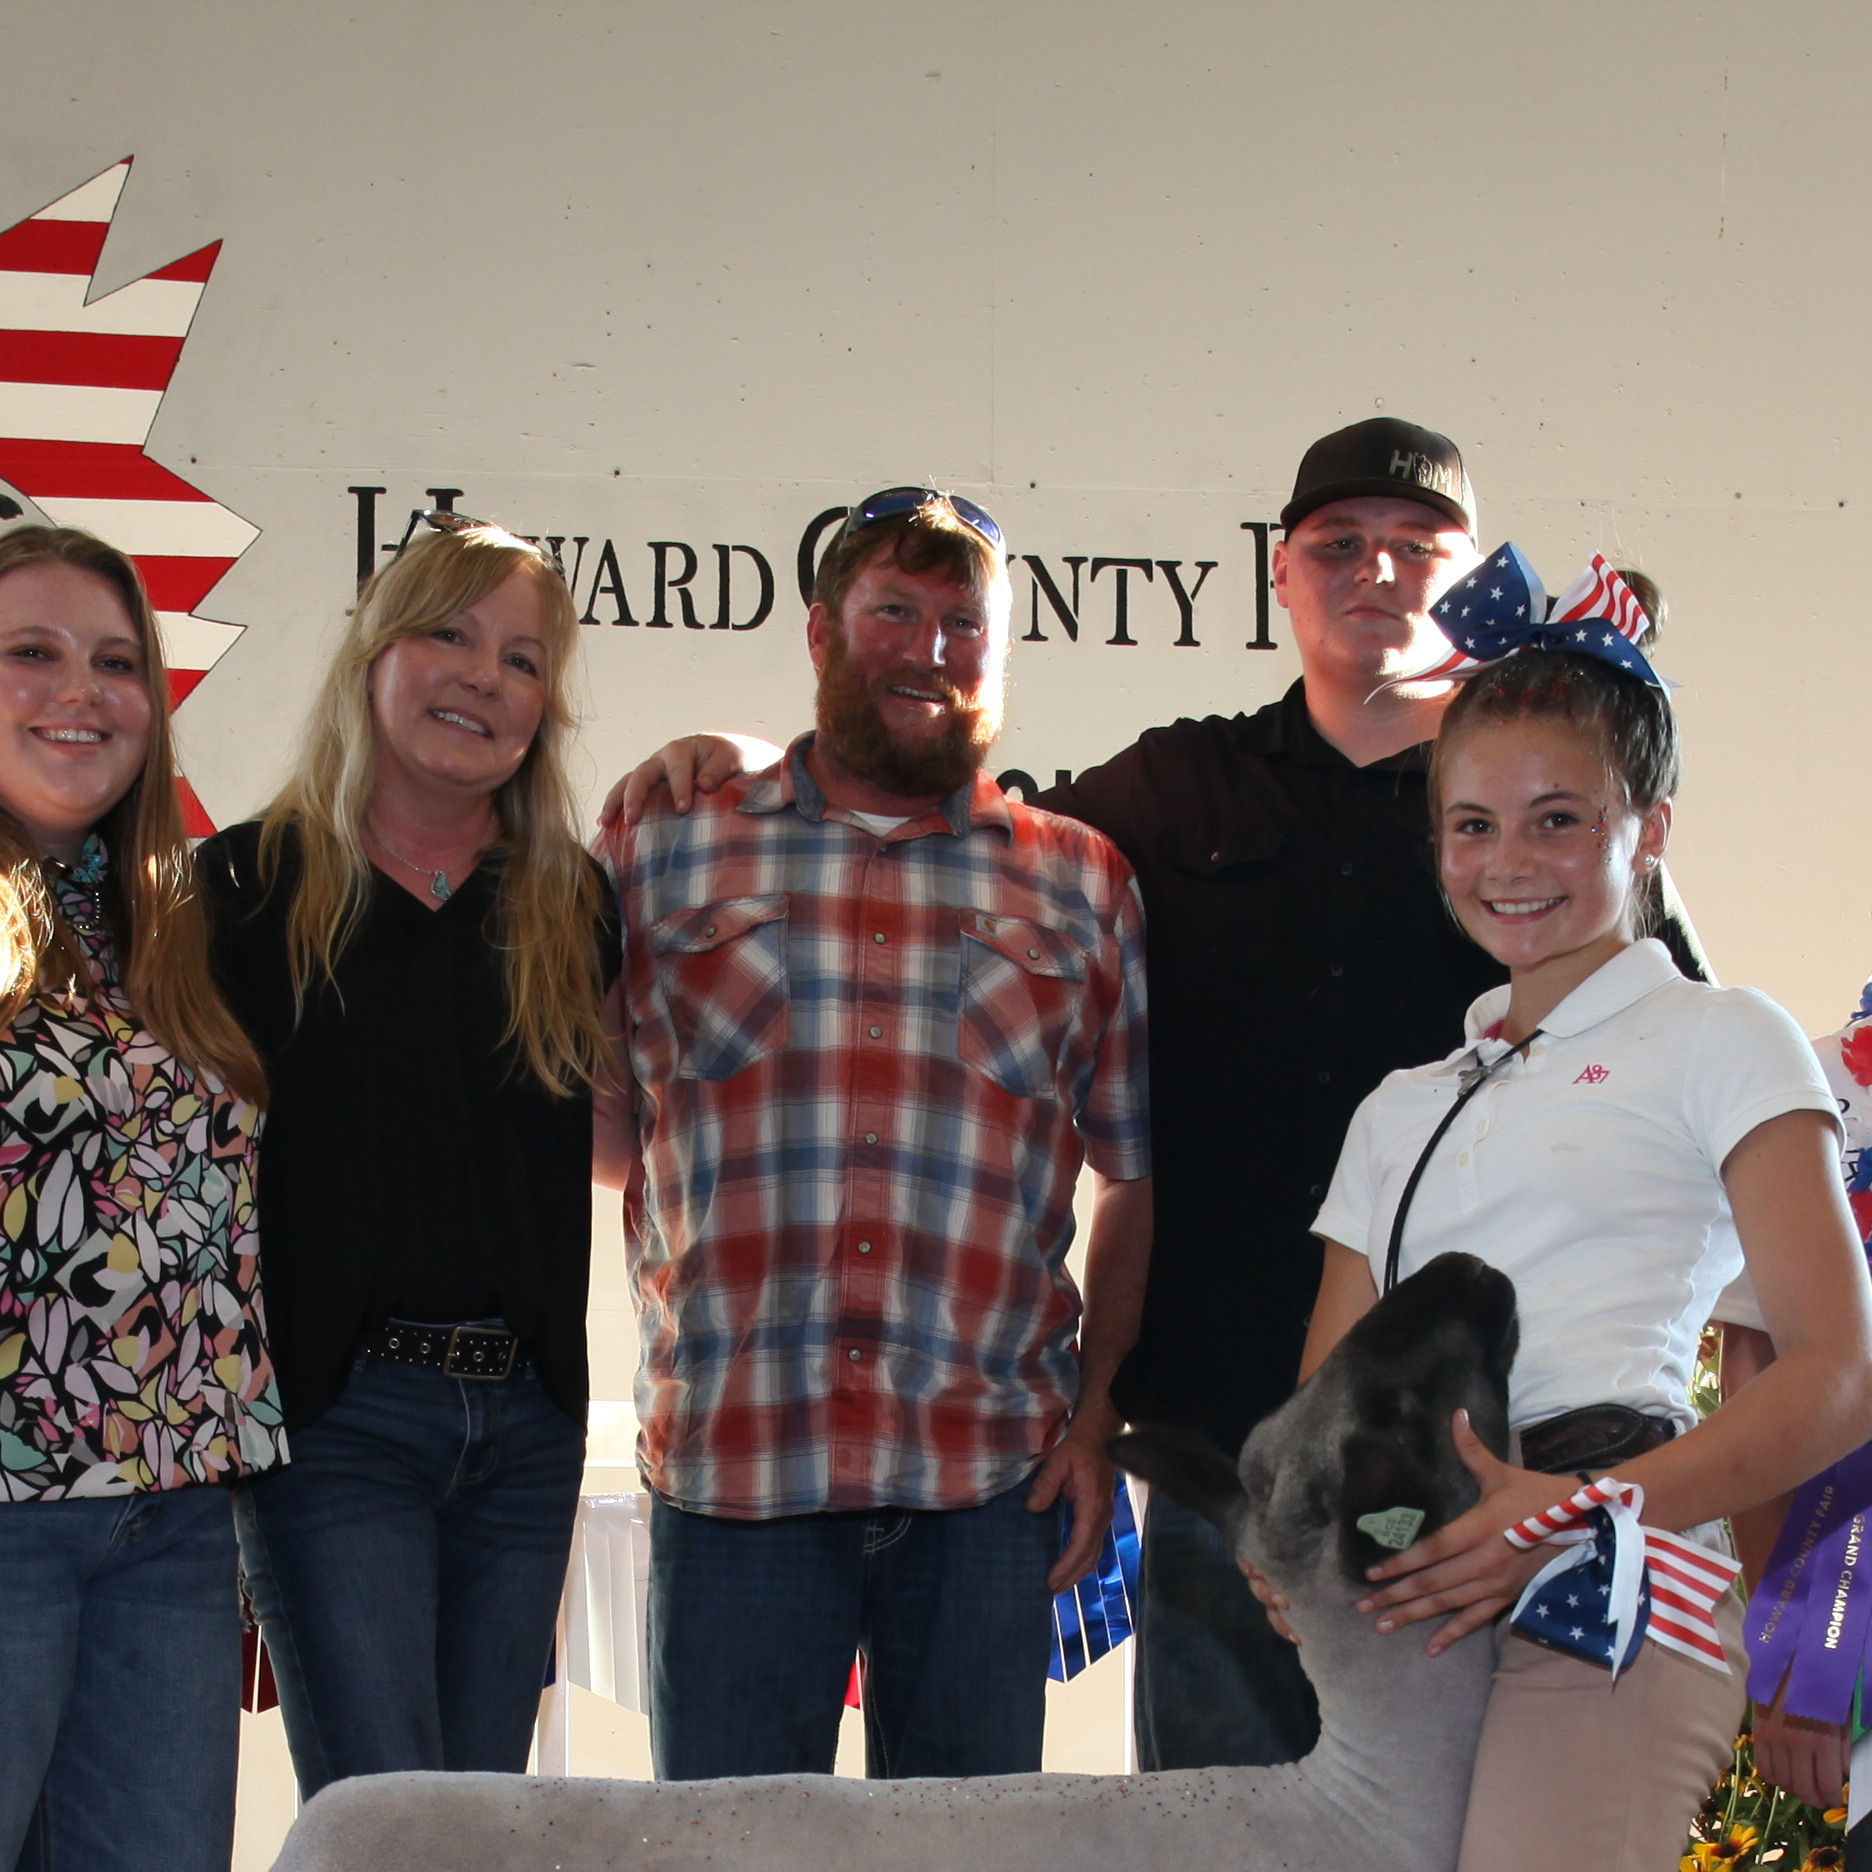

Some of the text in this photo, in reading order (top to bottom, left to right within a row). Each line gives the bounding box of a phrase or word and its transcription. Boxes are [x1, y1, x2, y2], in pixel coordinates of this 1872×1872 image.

[1759, 1578, 1795, 1644] HOWARD
[1791, 1517, 1822, 1578] COUNTY
[1824, 1513, 1867, 1650] GRAND CHAMPION
